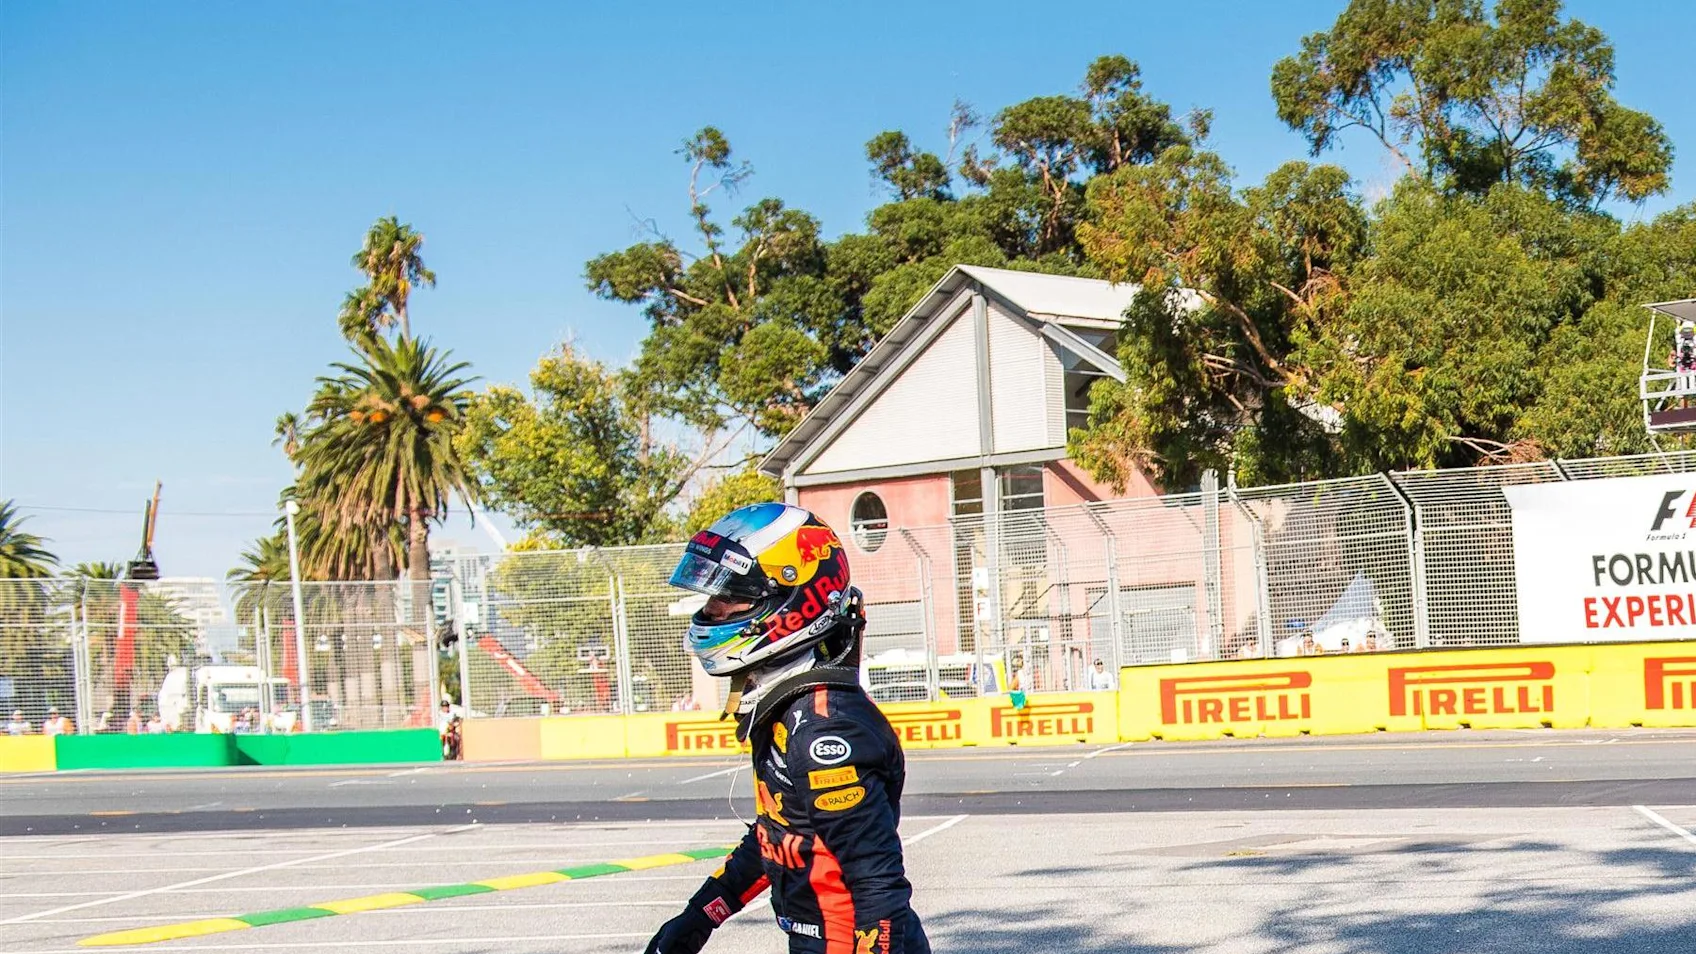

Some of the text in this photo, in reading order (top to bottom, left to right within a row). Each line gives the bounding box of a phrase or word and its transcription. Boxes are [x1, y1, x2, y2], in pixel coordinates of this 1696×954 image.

[764, 549, 850, 642] Red Bull
[1160, 671, 1312, 724] PIRELLI
[1389, 662, 1555, 715] PIRELLI
[666, 721, 752, 751] PIRE
[884, 710, 961, 742] ELLI
[991, 702, 1093, 737] PIRELLI
[828, 792, 859, 805] RAUCH
[878, 919, 891, 943] Bull
